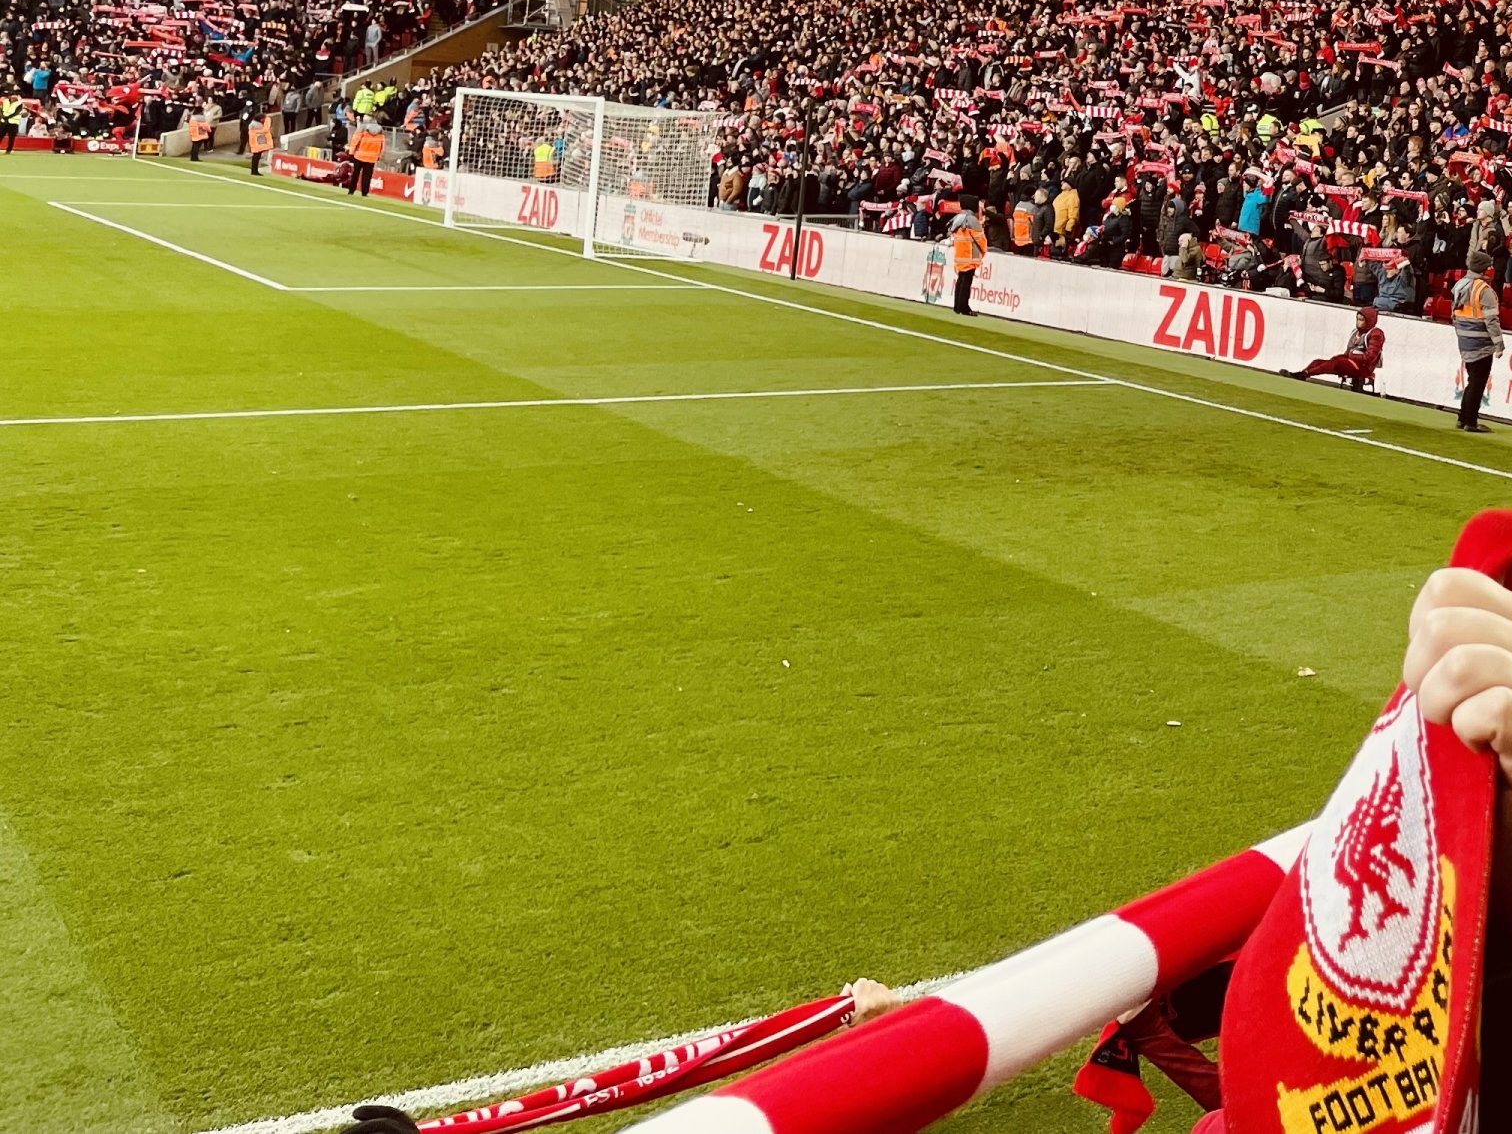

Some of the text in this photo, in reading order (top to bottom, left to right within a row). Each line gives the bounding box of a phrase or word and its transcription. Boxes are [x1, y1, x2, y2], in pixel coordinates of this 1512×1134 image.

[516, 185, 559, 228] ZAID
[759, 222, 824, 278] ZAID
[951, 277, 1021, 312] mbership
[1153, 284, 1266, 362] ZAID
